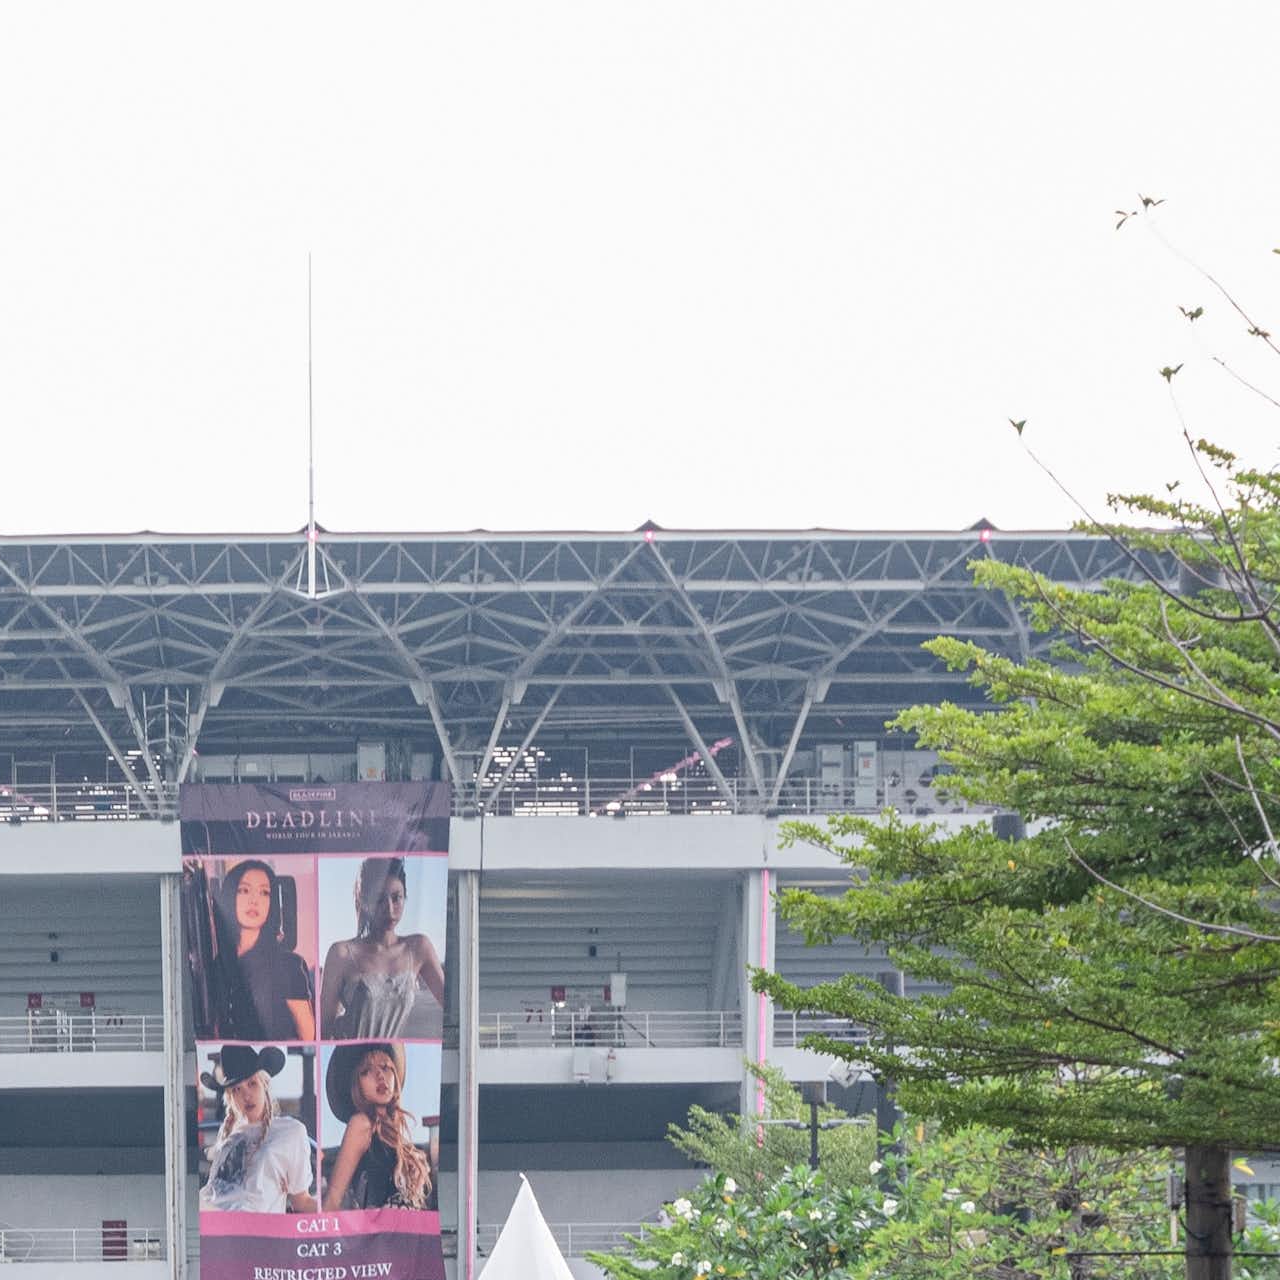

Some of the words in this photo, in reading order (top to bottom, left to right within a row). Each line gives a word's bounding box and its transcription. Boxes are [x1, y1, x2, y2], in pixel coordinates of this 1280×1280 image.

[296, 1218, 329, 1233] CAT
[332, 1217, 340, 1231] 1
[296, 1243, 329, 1257] CAT
[333, 1242, 342, 1256] 3
[351, 1263, 392, 1279] VIEW
